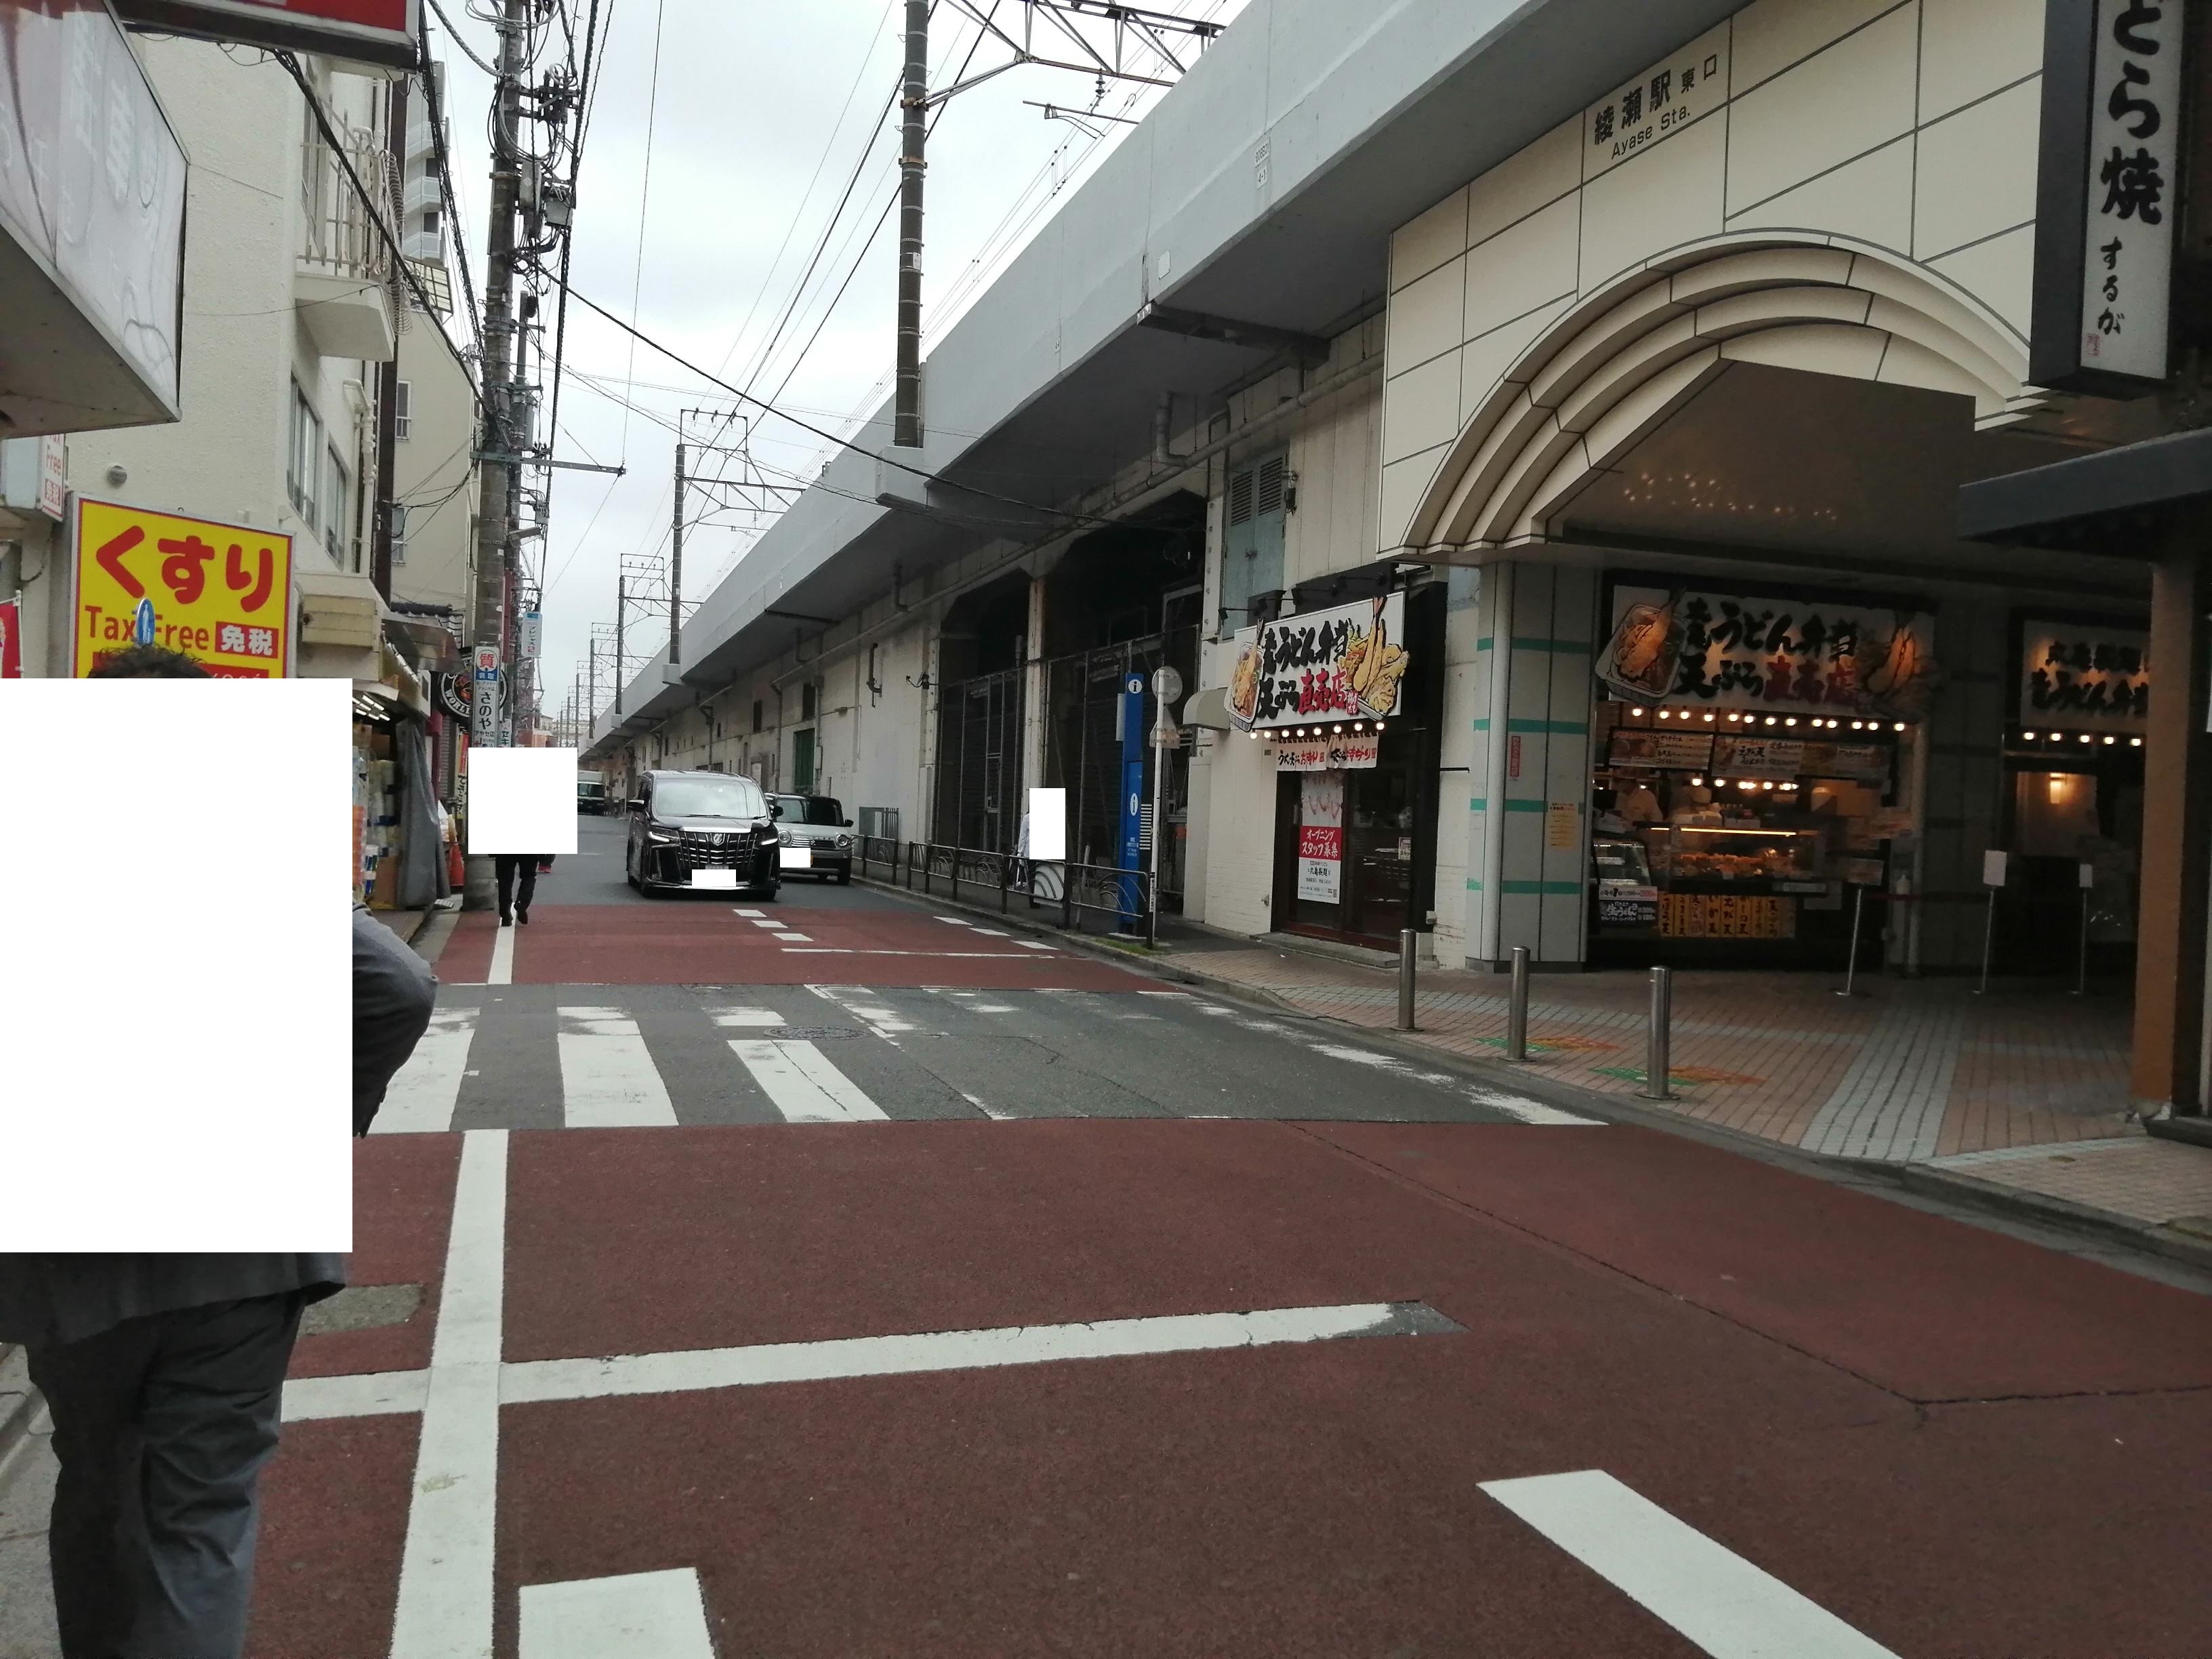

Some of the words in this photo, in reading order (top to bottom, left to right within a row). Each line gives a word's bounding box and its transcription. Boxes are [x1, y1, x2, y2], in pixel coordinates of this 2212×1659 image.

[1594, 68, 1671, 145] 綾瀬駅
[1681, 54, 1717, 94] 東口
[1612, 125, 1653, 160] Ayase
[1660, 105, 1690, 131] Sta.
[2098, 237, 2125, 335] するが
[96, 525, 273, 613] くすり
[85, 605, 137, 642] Tax
[220, 624, 273, 656] 免税
[480, 653, 495, 668] 質
[478, 692, 492, 729] さのや
[1301, 841, 1338, 859] スタッフ募集
[1307, 829, 1335, 841] オープニング
